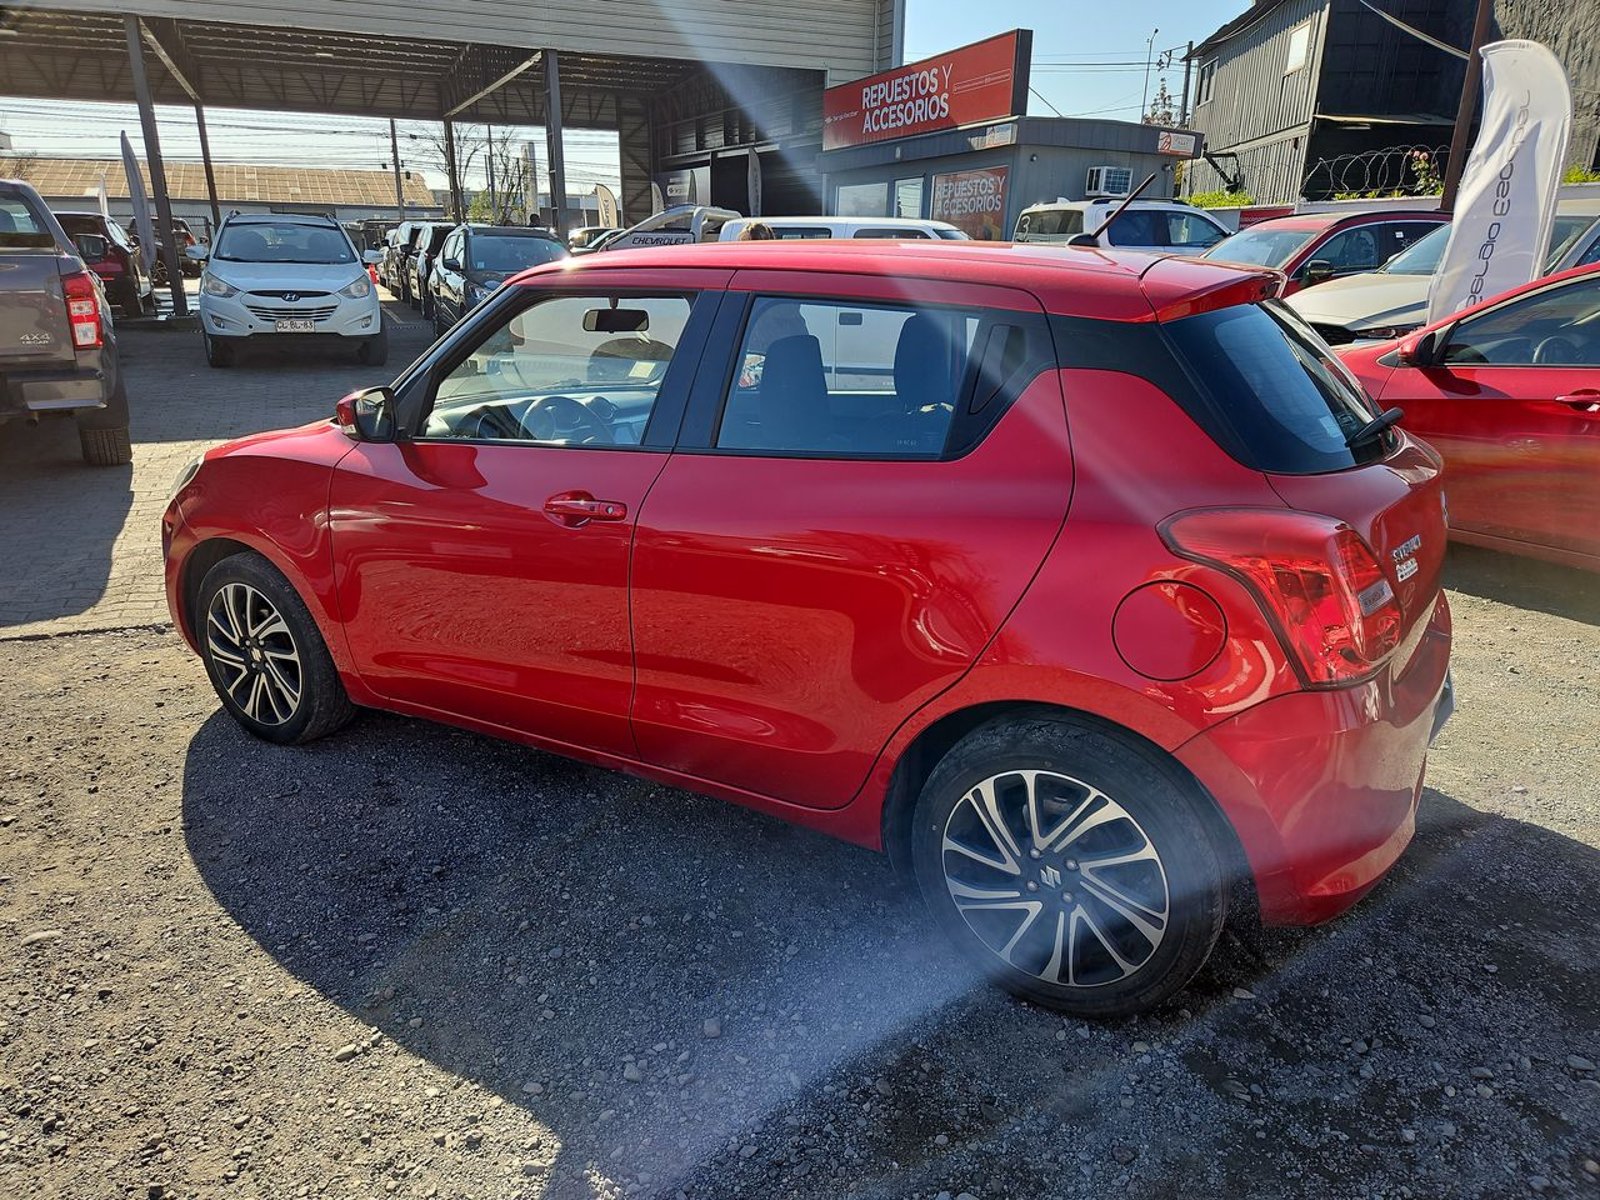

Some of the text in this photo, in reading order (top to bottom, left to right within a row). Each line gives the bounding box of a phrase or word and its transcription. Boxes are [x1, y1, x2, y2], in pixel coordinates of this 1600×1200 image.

[862, 67, 939, 110] REPUESTOS
[942, 63, 954, 90] Y
[862, 92, 949, 134] ACCESORIOS
[936, 175, 1006, 199] REPUESTOS Y
[935, 194, 1002, 216] ACCESORIOS
[632, 236, 688, 246] CHEVROLET
